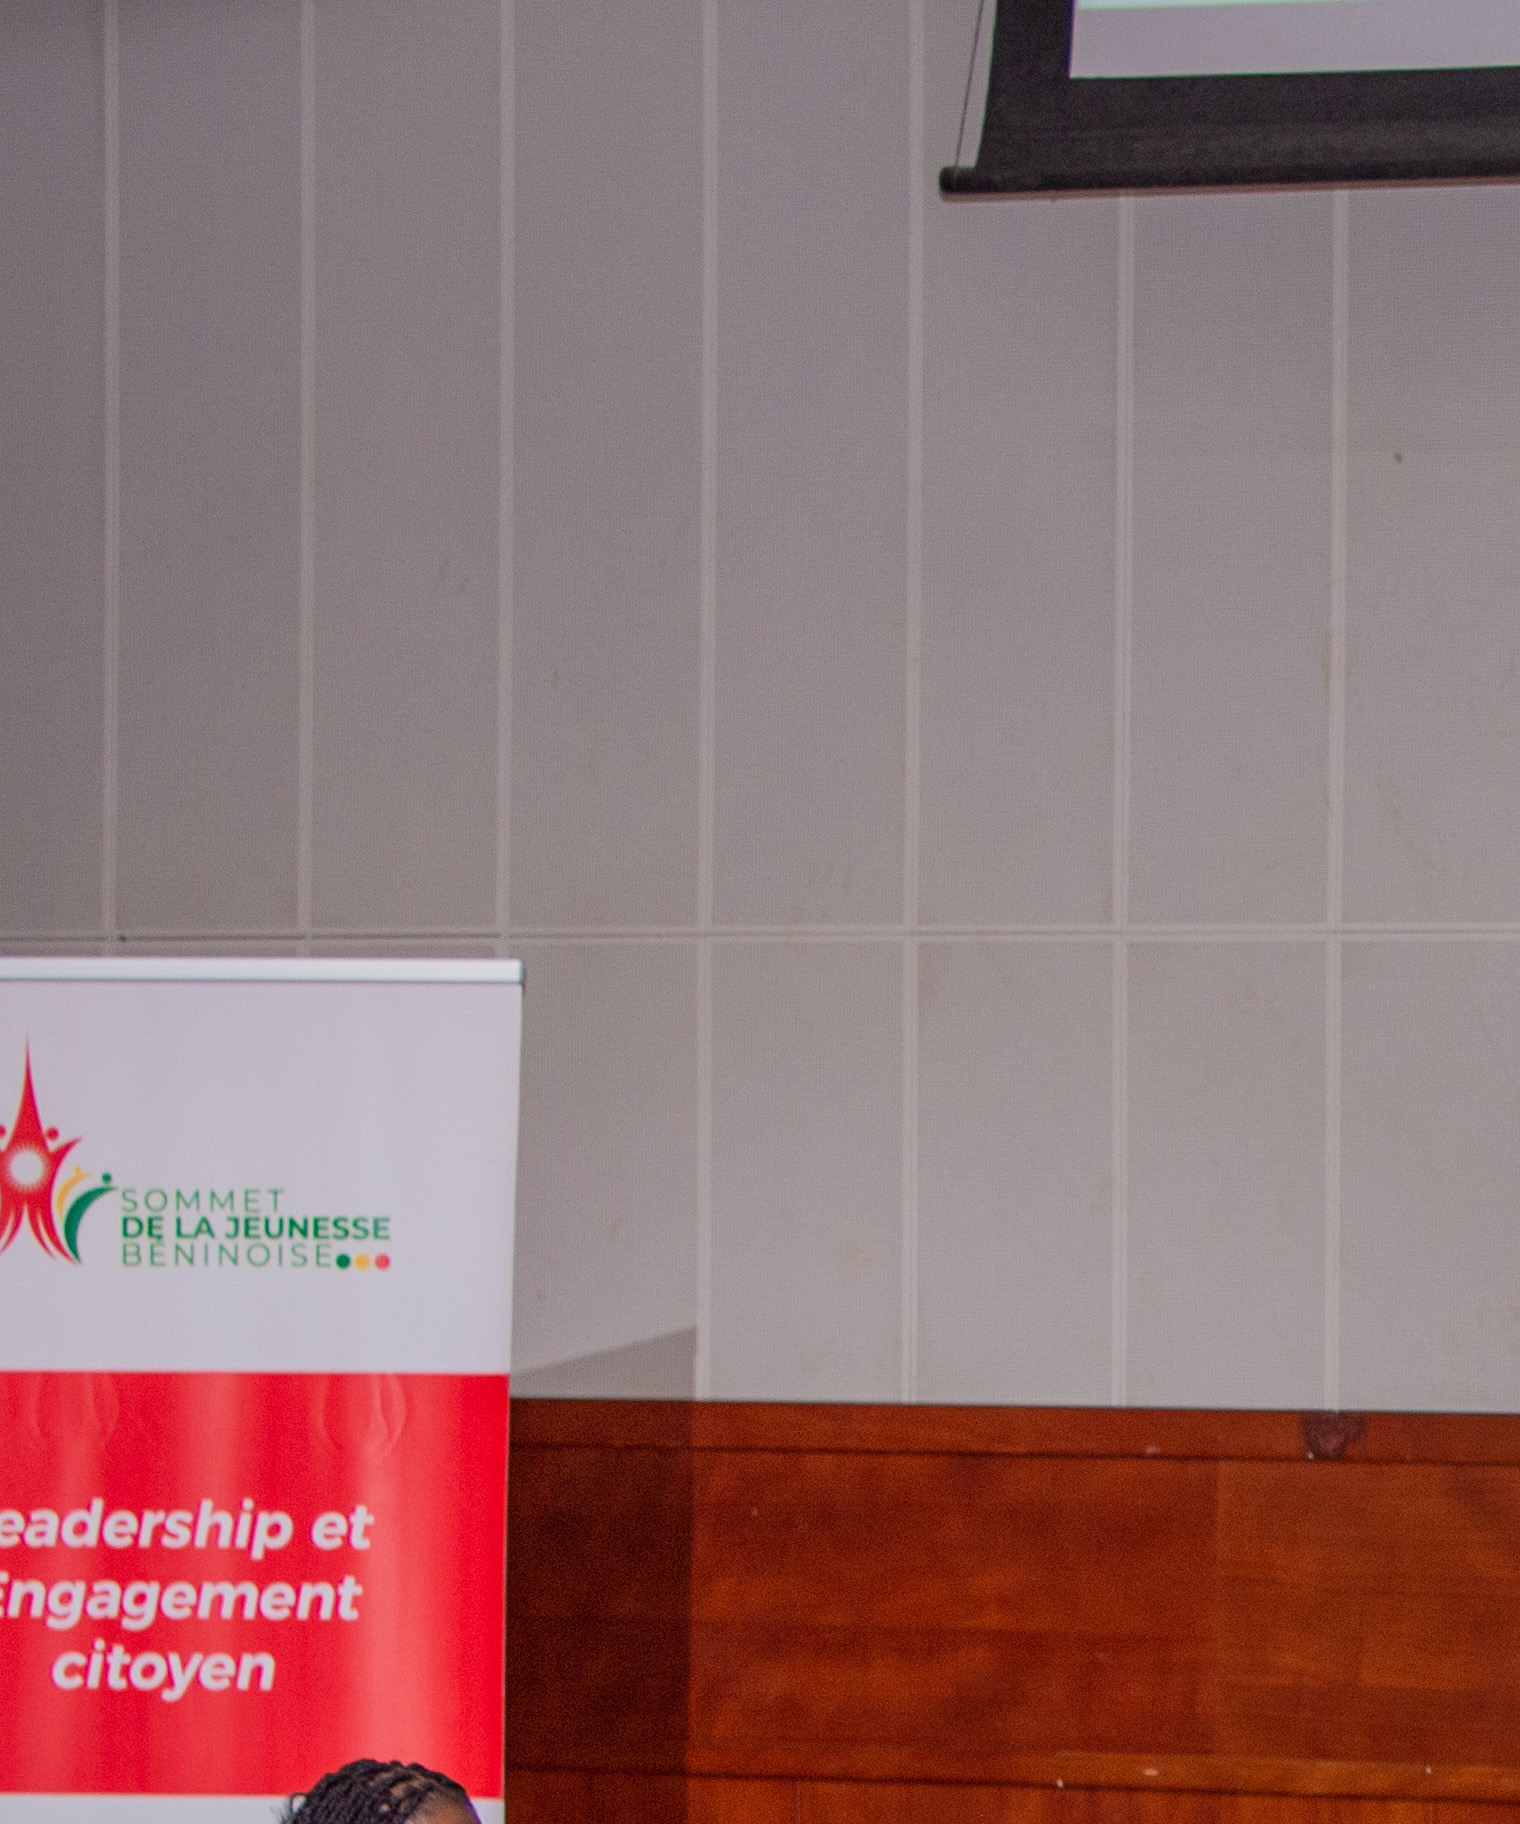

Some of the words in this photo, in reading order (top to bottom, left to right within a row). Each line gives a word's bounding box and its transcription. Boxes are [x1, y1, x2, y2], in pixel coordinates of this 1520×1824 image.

[121, 1188, 283, 1213] SOMMET
[122, 1216, 163, 1241] DE
[176, 1216, 215, 1238] LA
[226, 1217, 388, 1239] JEUNESSE
[122, 1238, 330, 1267] BÉNINOISE
[0, 1498, 293, 1560] eadership
[311, 1504, 374, 1550] et
[52, 1639, 275, 1702] citoyen
